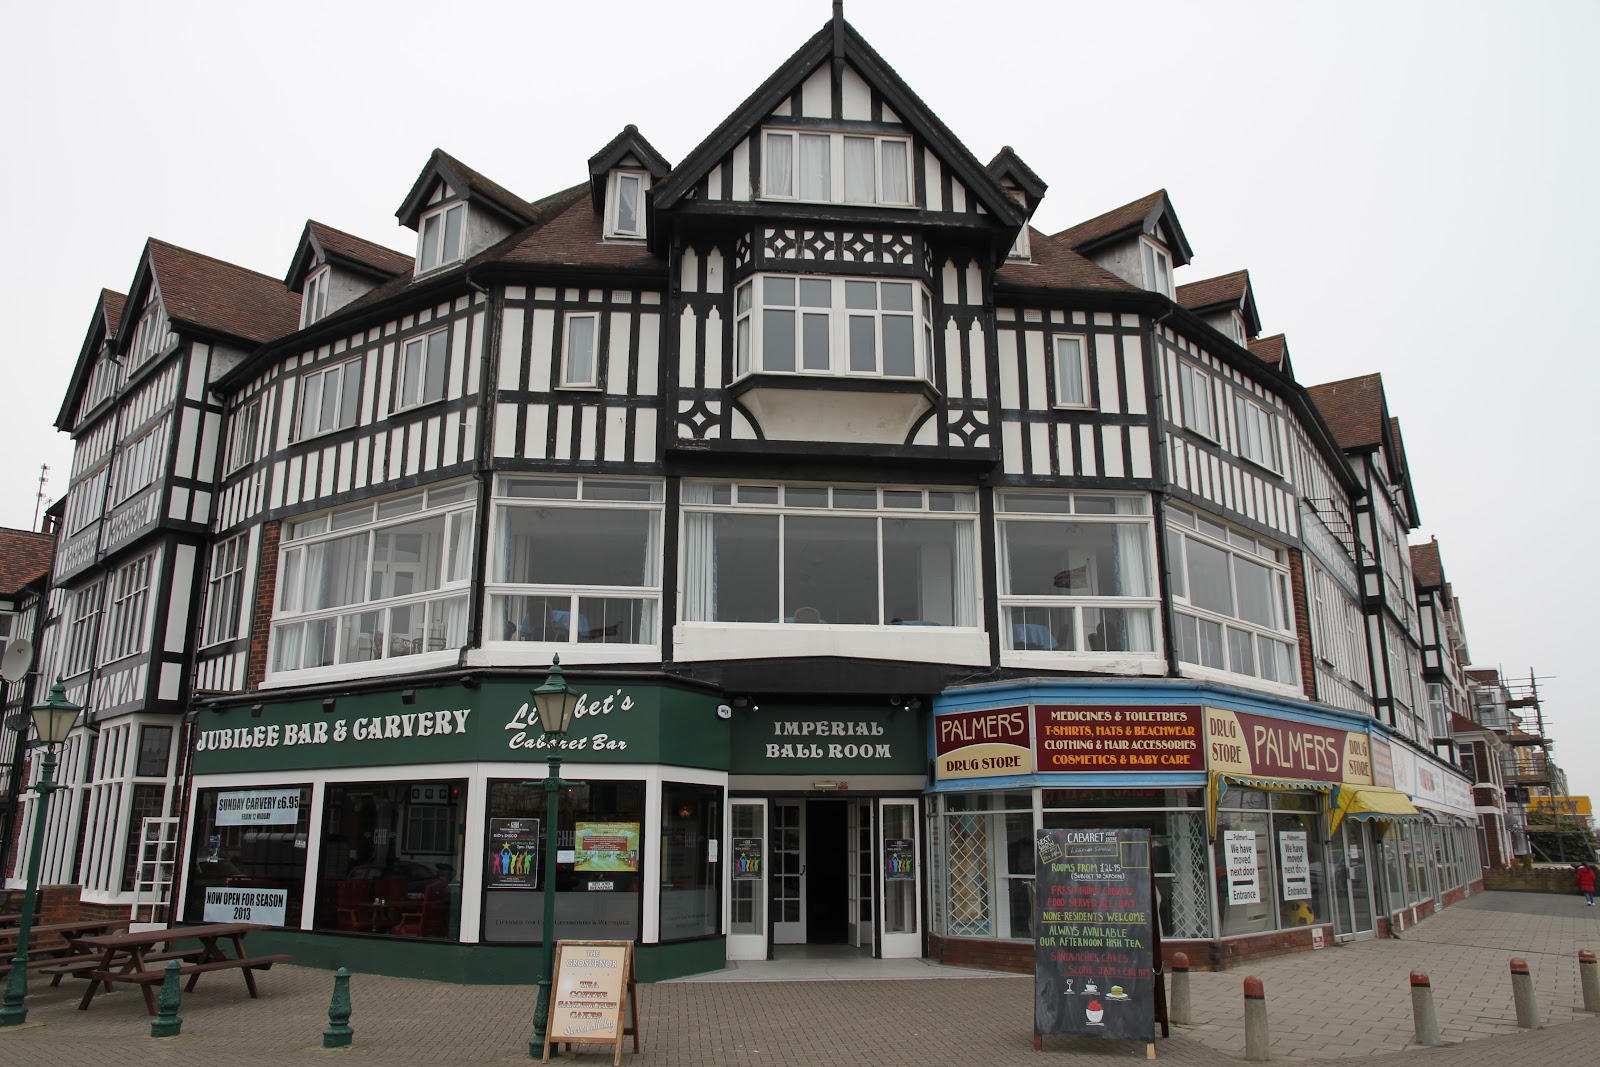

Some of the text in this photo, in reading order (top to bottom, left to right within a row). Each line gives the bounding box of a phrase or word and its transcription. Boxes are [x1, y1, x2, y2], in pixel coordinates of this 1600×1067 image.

[505, 688, 634, 730] Libet's
[1051, 711, 1188, 722] MEDICINES & TOILETRIES
[197, 709, 471, 752] JUBILEE BAR & CARVERY
[774, 721, 884, 736] IMPERIAL
[941, 712, 1025, 743] PALMERS
[1044, 725, 1195, 738] T-SHIRTS, HATS & BEACHWEAR
[1209, 717, 1236, 739] DRUG
[592, 733, 627, 751] Bar
[1044, 740, 1197, 750] CLOTHING & HAIR ACCESSORIES
[765, 743, 892, 758] BALL ROOM
[1212, 742, 1242, 764] STORE
[1253, 725, 1339, 773] PALMERS
[1348, 739, 1368, 757] DRUG
[946, 755, 1022, 772] DRUG STORE
[1052, 754, 1191, 765] COSMETICS & BABY CARE
[1348, 760, 1370, 777] STORE
[219, 796, 299, 811] SUNDAY CARVERY £6.95
[1067, 832, 1105, 843] CABARET
[1230, 844, 1252, 854] We have
[1284, 844, 1304, 853] We have
[1233, 855, 1251, 865] moved
[1286, 855, 1303, 864] moved
[1051, 863, 1076, 873] ROOMS
[1077, 863, 1098, 873] FROM
[1230, 866, 1255, 877] next door
[1284, 865, 1307, 875] next door
[1051, 885, 1077, 895] FRESH
[1079, 886, 1098, 895] HOME
[1233, 889, 1257, 901] Entrance
[1287, 886, 1308, 897] Entrance
[206, 891, 284, 907] NOW OPEN FOR SEASON
[1047, 898, 1136, 908] FOOD SERVED ALL DAY
[233, 907, 251, 921] 2013
[1043, 911, 1145, 922] NONE-RESIDENTS WELCOME
[1049, 925, 1127, 937] ALWAYS AVAILABLE
[1039, 936, 1056, 946] OUR
[1059, 937, 1103, 947] AFTERNOON
[1106, 938, 1122, 947] HIGH
[566, 959, 617, 968] GROSVENOR
[1098, 967, 1116, 976] JAM
[1122, 967, 1151, 977] CREAM
[579, 981, 600, 989] TEA
[569, 990, 608, 999] COFFEE
[557, 1000, 617, 1010] SANDWICHES
[569, 1011, 603, 1020] CAKES
